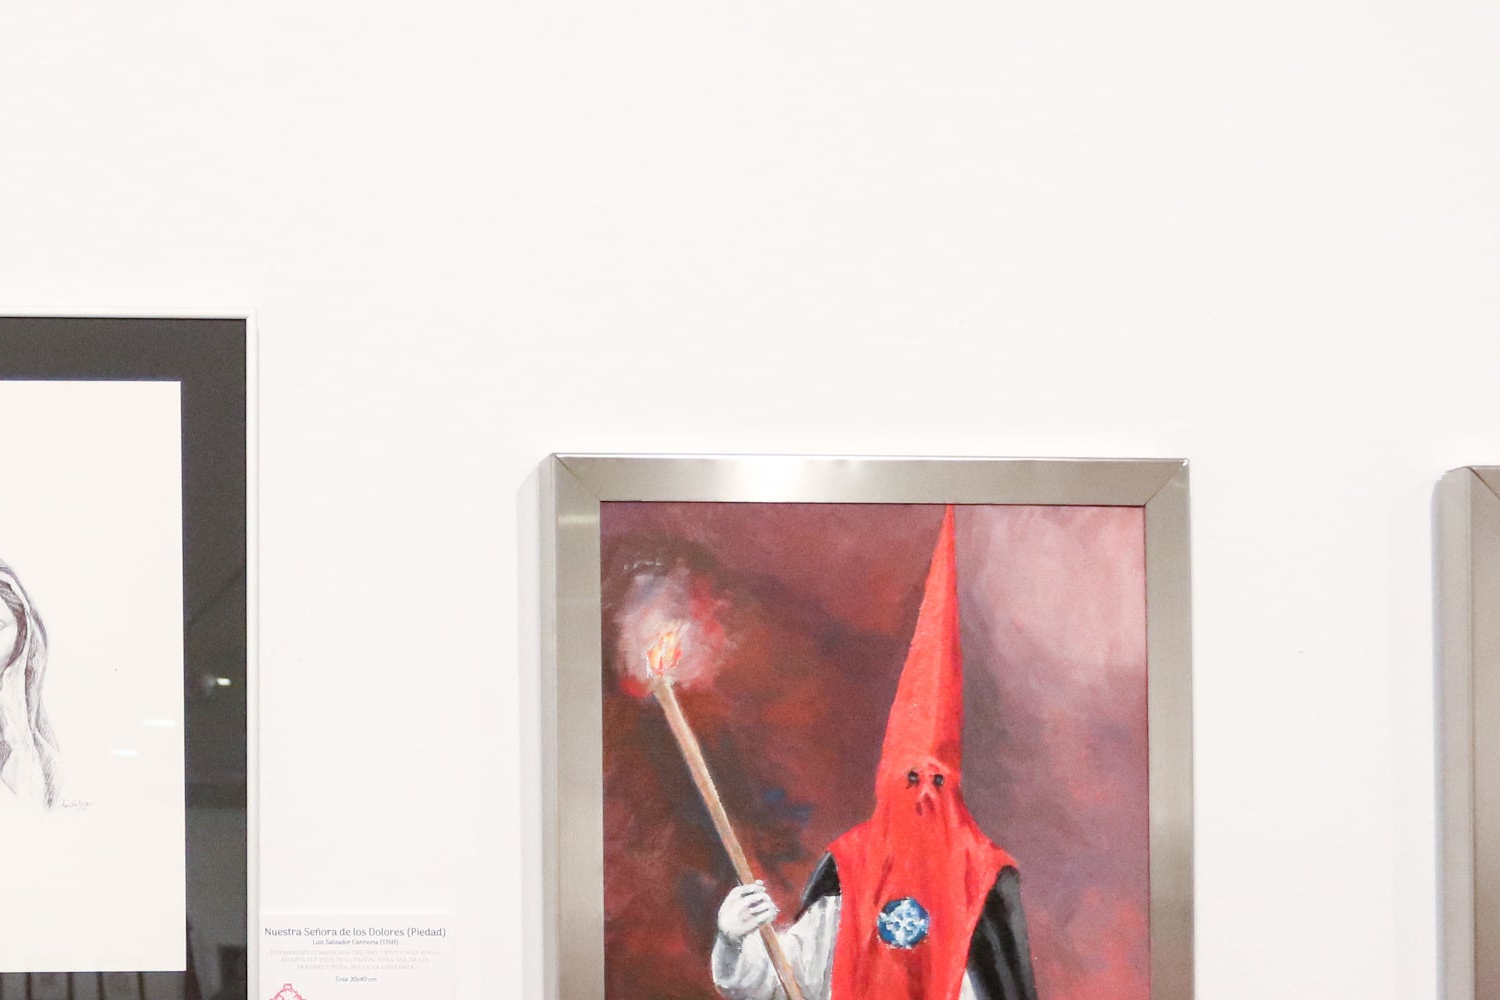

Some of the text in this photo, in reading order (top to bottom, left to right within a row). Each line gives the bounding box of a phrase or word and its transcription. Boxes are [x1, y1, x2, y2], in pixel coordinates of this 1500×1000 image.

[264, 927, 446, 937] Nuestra Señora de los Dolores (Piedad)
